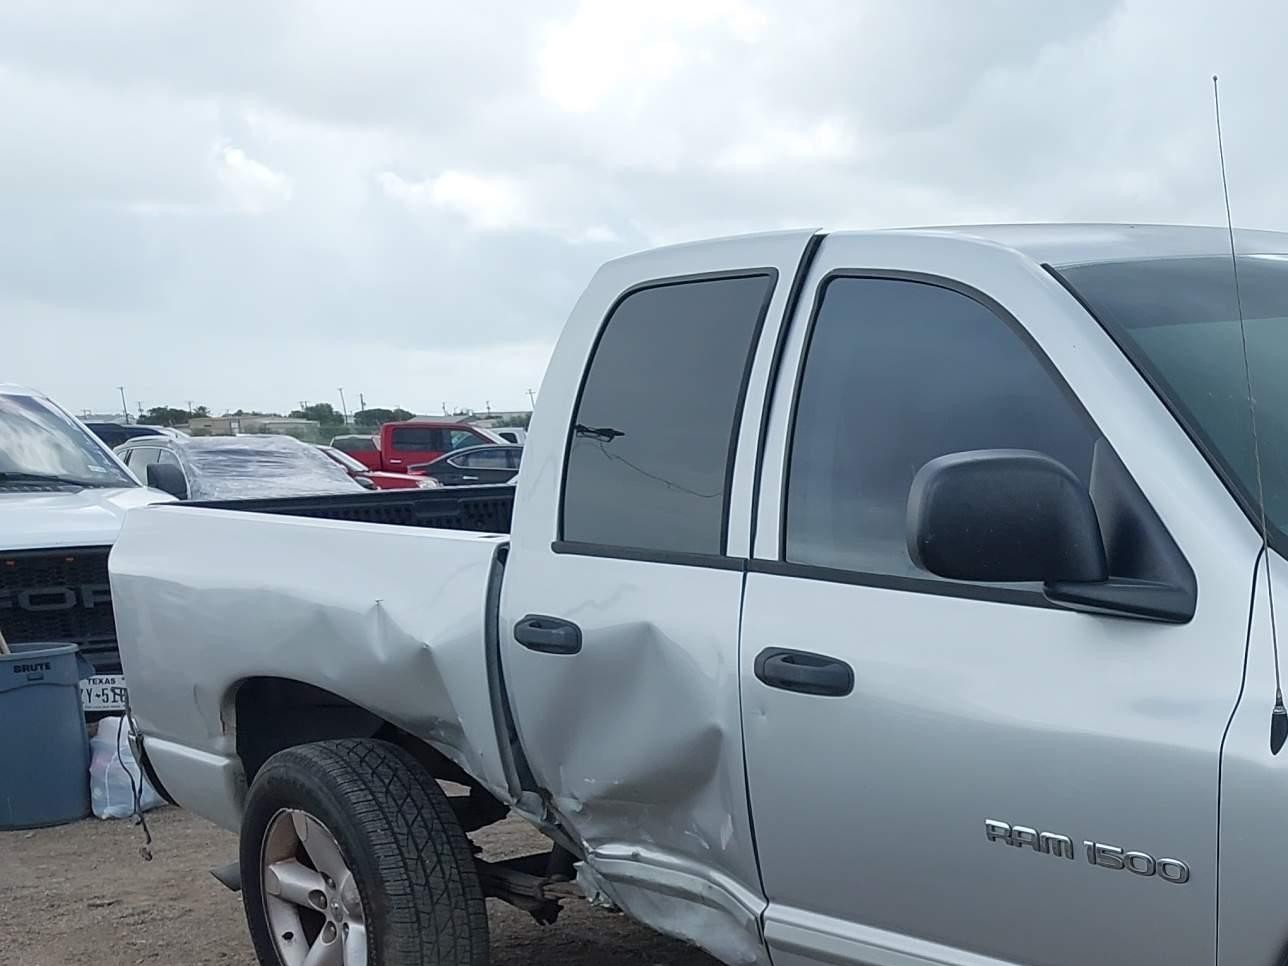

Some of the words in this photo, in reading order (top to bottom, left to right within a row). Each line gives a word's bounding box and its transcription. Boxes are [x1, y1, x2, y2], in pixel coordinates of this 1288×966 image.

[13, 662, 51, 673] BRUTE
[984, 818, 1074, 861] RAM
[1083, 840, 1191, 885] 1500
